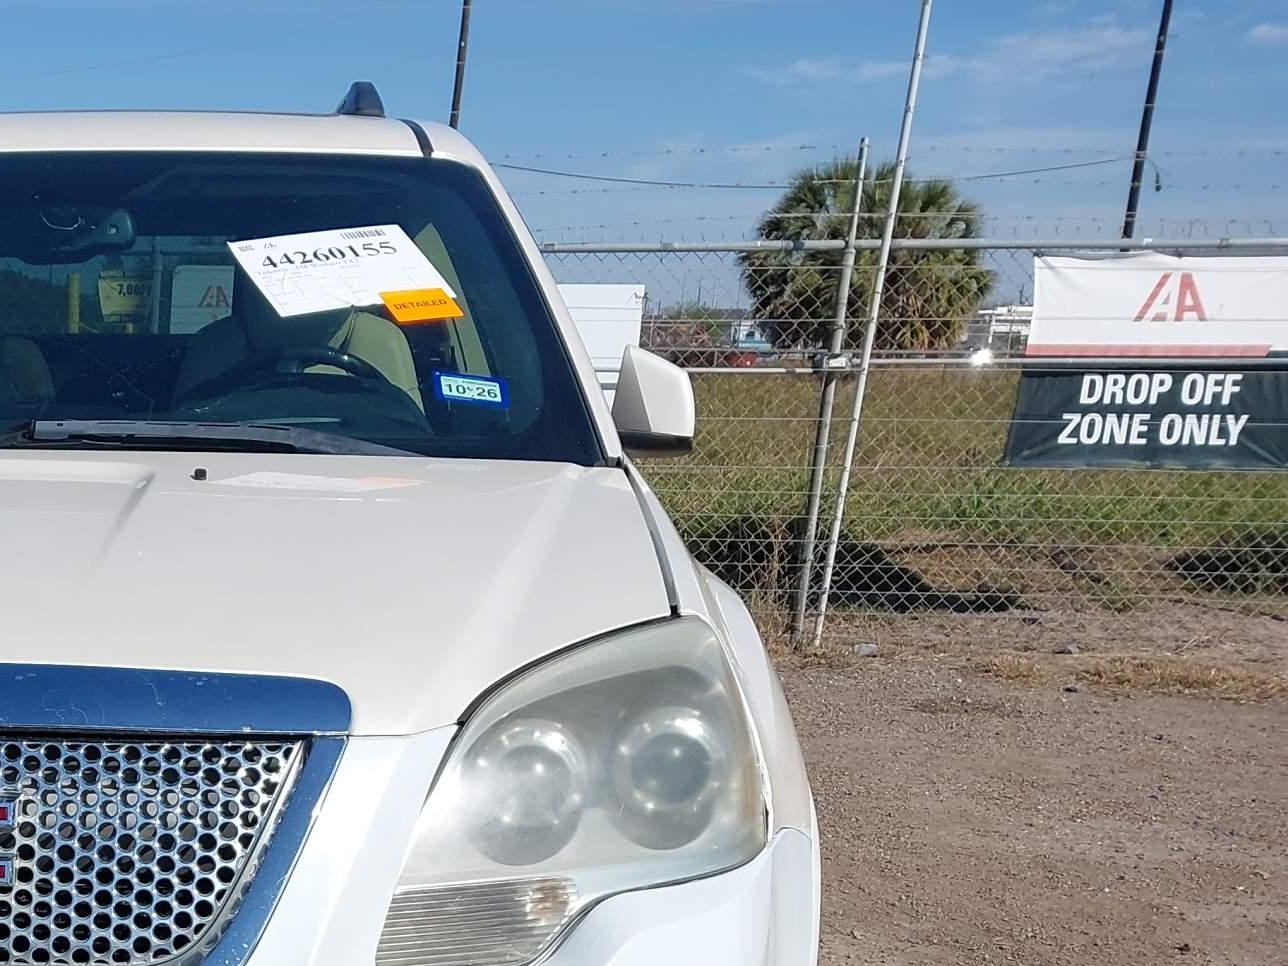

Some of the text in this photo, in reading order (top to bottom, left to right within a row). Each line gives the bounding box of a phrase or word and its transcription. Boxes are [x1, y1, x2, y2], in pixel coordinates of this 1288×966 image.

[261, 240, 398, 269] 44260155
[393, 298, 448, 310] DETAILED
[1079, 373, 1243, 405] DROP OFF
[1057, 412, 1250, 446] ZONE ONLY
